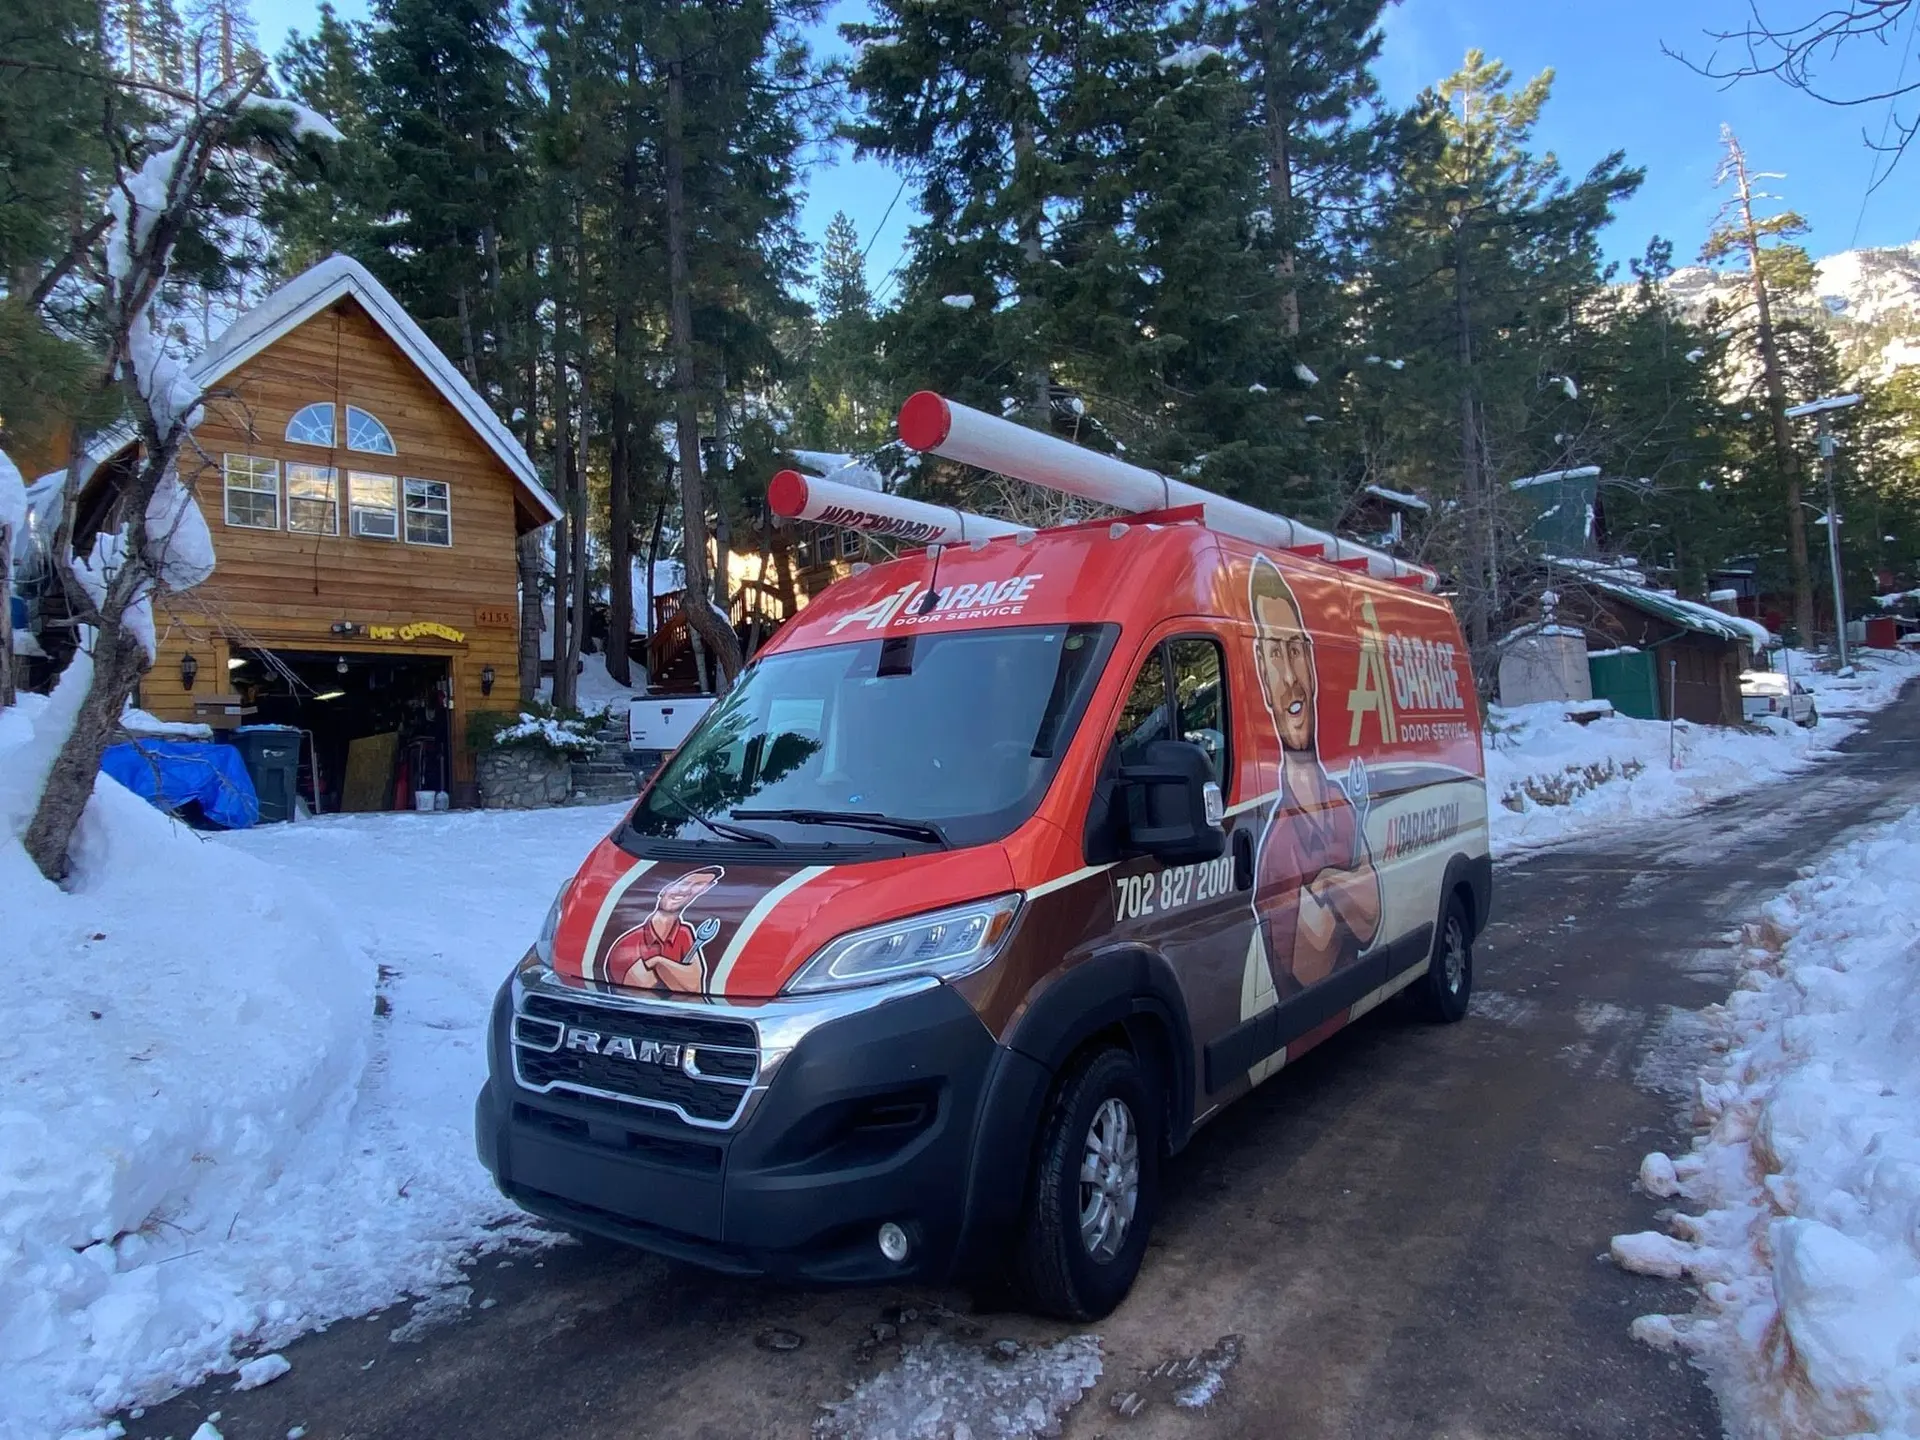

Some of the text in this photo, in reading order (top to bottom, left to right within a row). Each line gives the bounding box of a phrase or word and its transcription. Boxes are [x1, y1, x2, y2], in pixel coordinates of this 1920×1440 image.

[479, 611, 509, 623] 4155
[826, 581, 921, 636] A1
[894, 605, 1024, 626] DOOR SERVICE
[1347, 592, 1464, 746] A1 GARAGE
[1401, 721, 1469, 742] DOOR SERVICE
[1117, 856, 1236, 921] 702 827 2001
[566, 1028, 681, 1067] RAM
